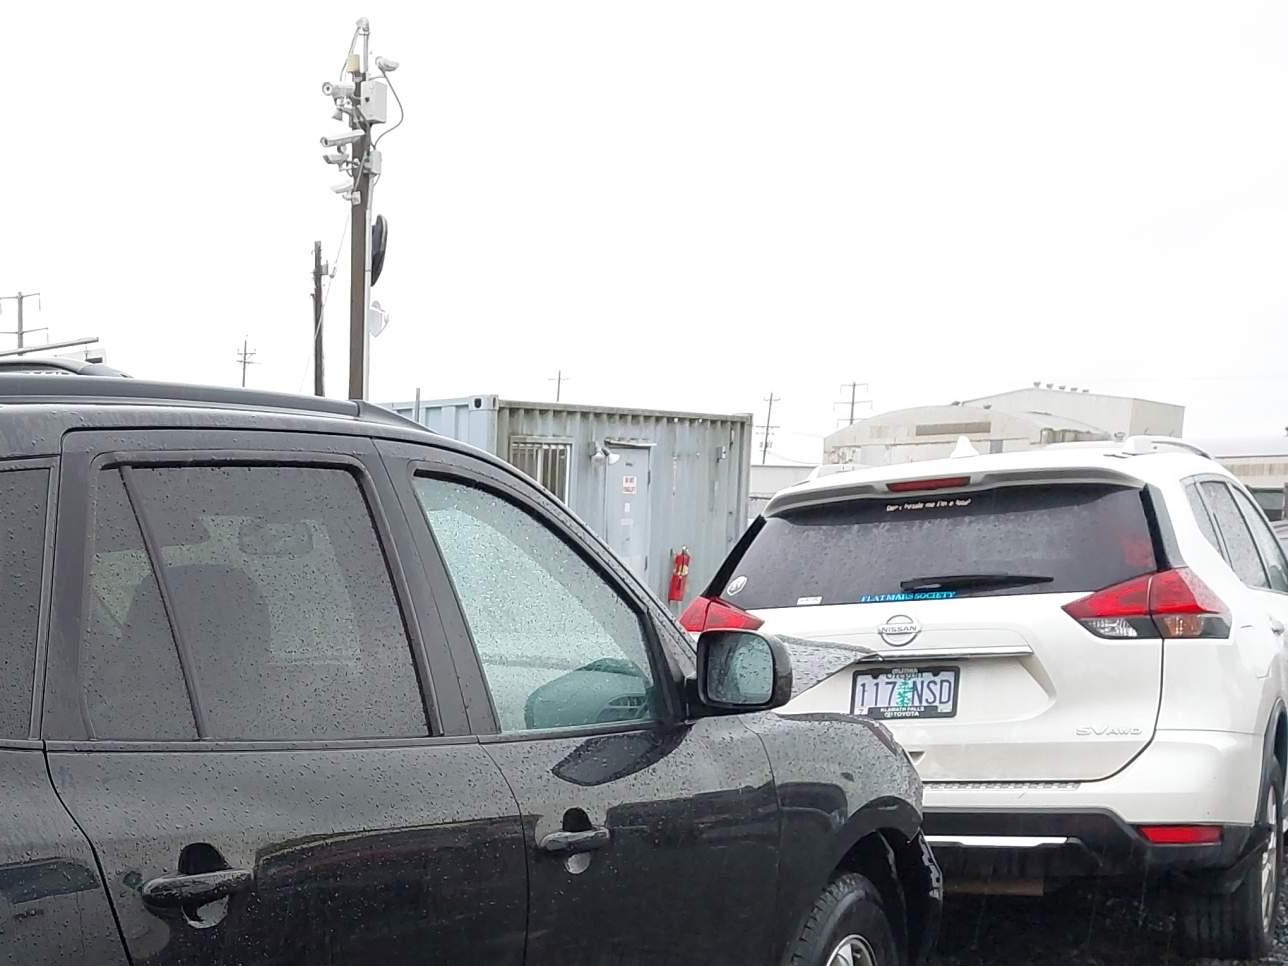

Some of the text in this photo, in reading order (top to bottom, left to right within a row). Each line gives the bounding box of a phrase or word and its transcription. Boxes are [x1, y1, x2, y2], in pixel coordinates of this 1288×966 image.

[914, 591, 956, 600] SOCIETY
[881, 625, 917, 633] NISSAN
[913, 680, 951, 706] NSD
